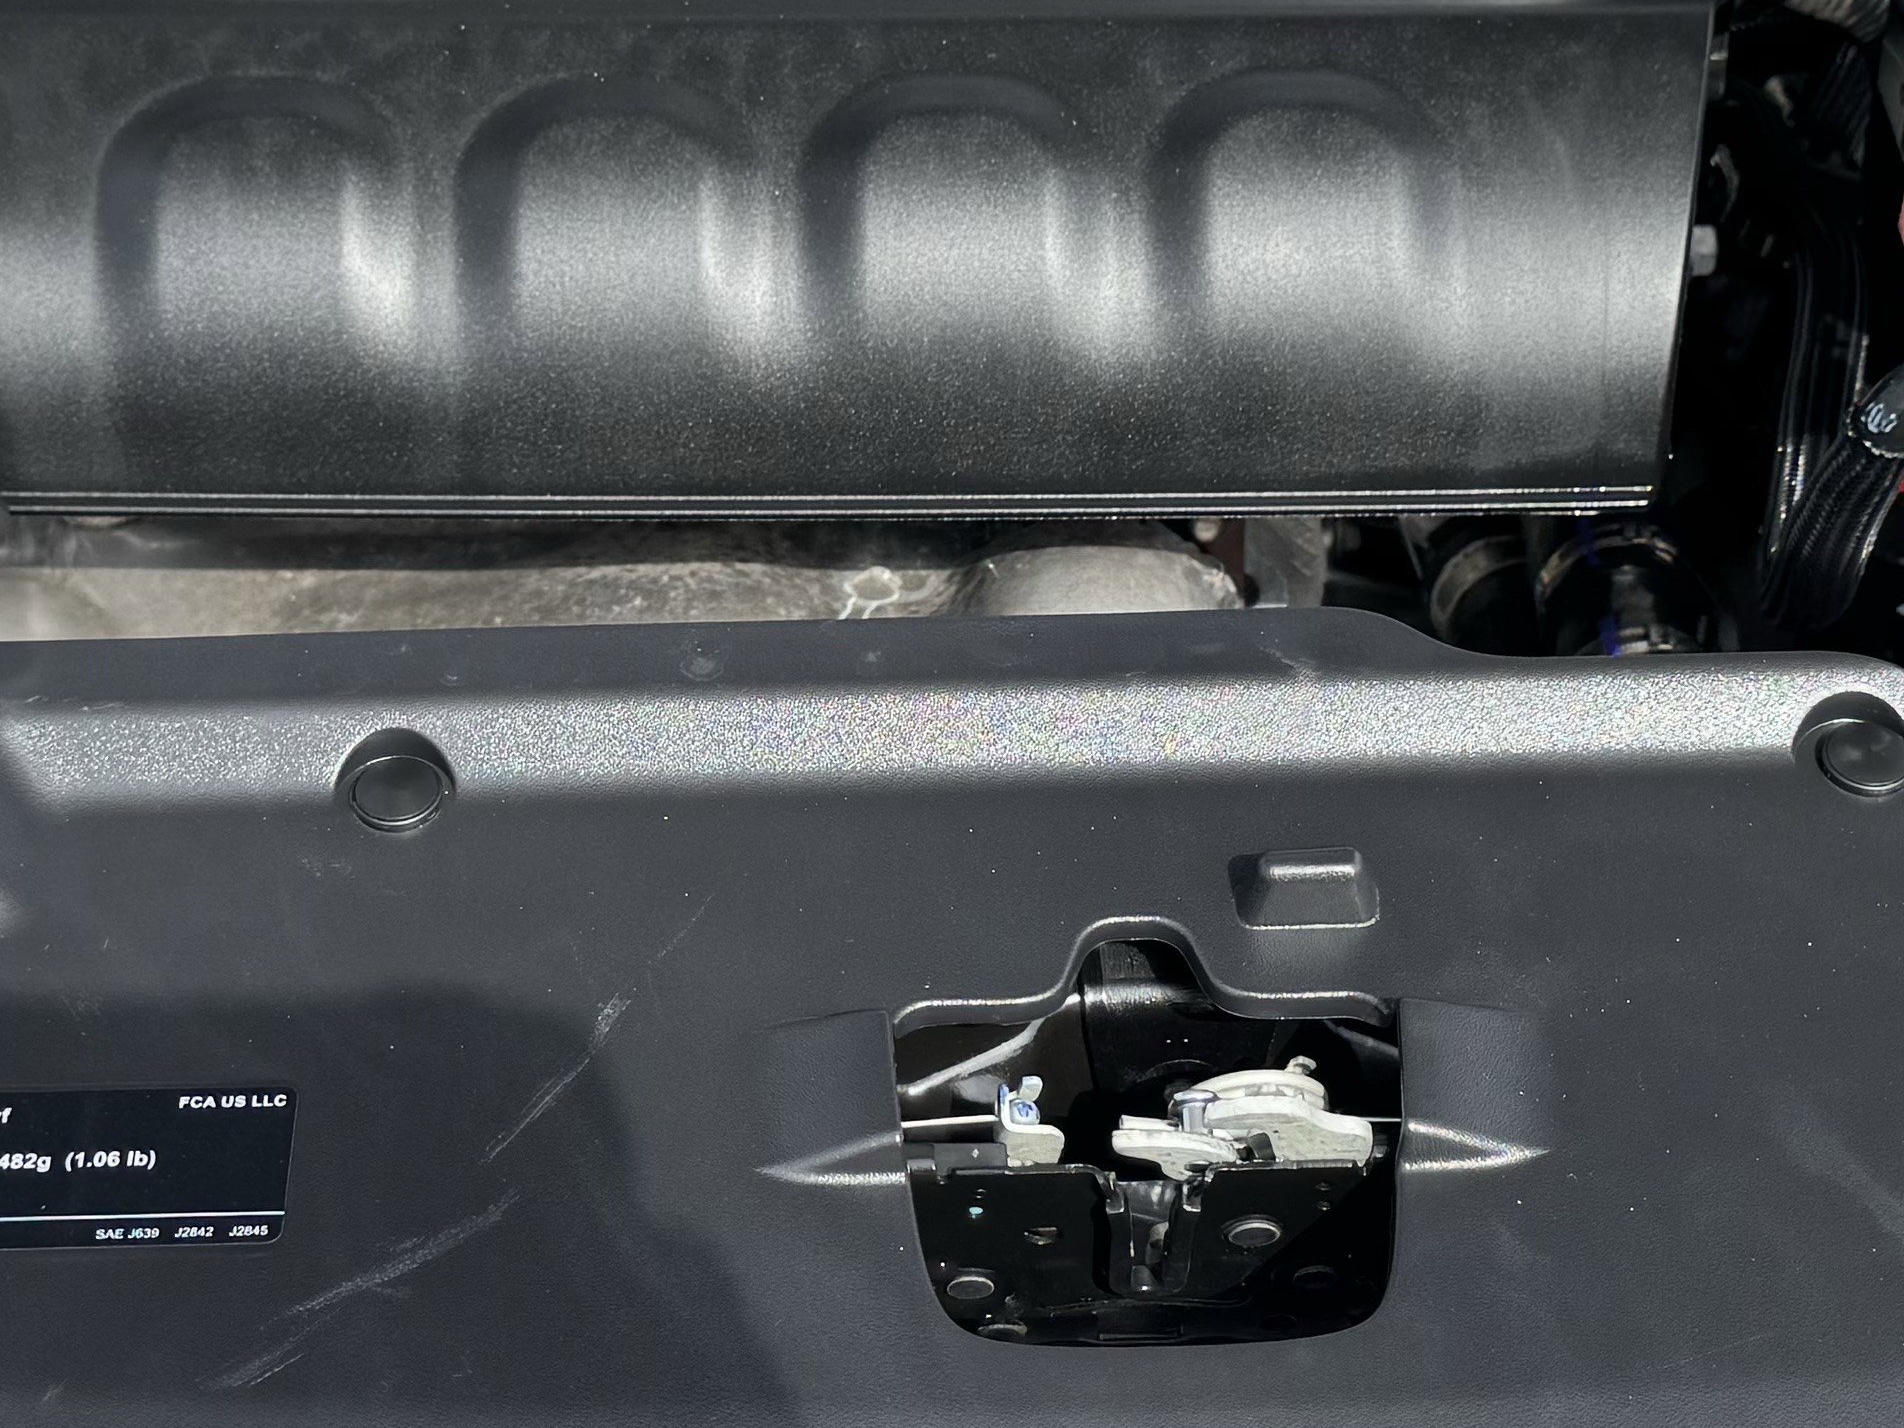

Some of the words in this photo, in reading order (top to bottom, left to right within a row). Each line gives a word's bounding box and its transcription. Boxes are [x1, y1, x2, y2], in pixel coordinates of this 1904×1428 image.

[178, 1095, 217, 1109] FCA
[220, 1094, 247, 1109] US
[251, 1093, 288, 1108] LLC
[64, 1150, 121, 1172] (1.06
[126, 1149, 157, 1171] lb)
[95, 1228, 124, 1240] SAE
[127, 1227, 160, 1239] J639
[174, 1225, 215, 1238] J2842
[228, 1224, 269, 1237] J2845
